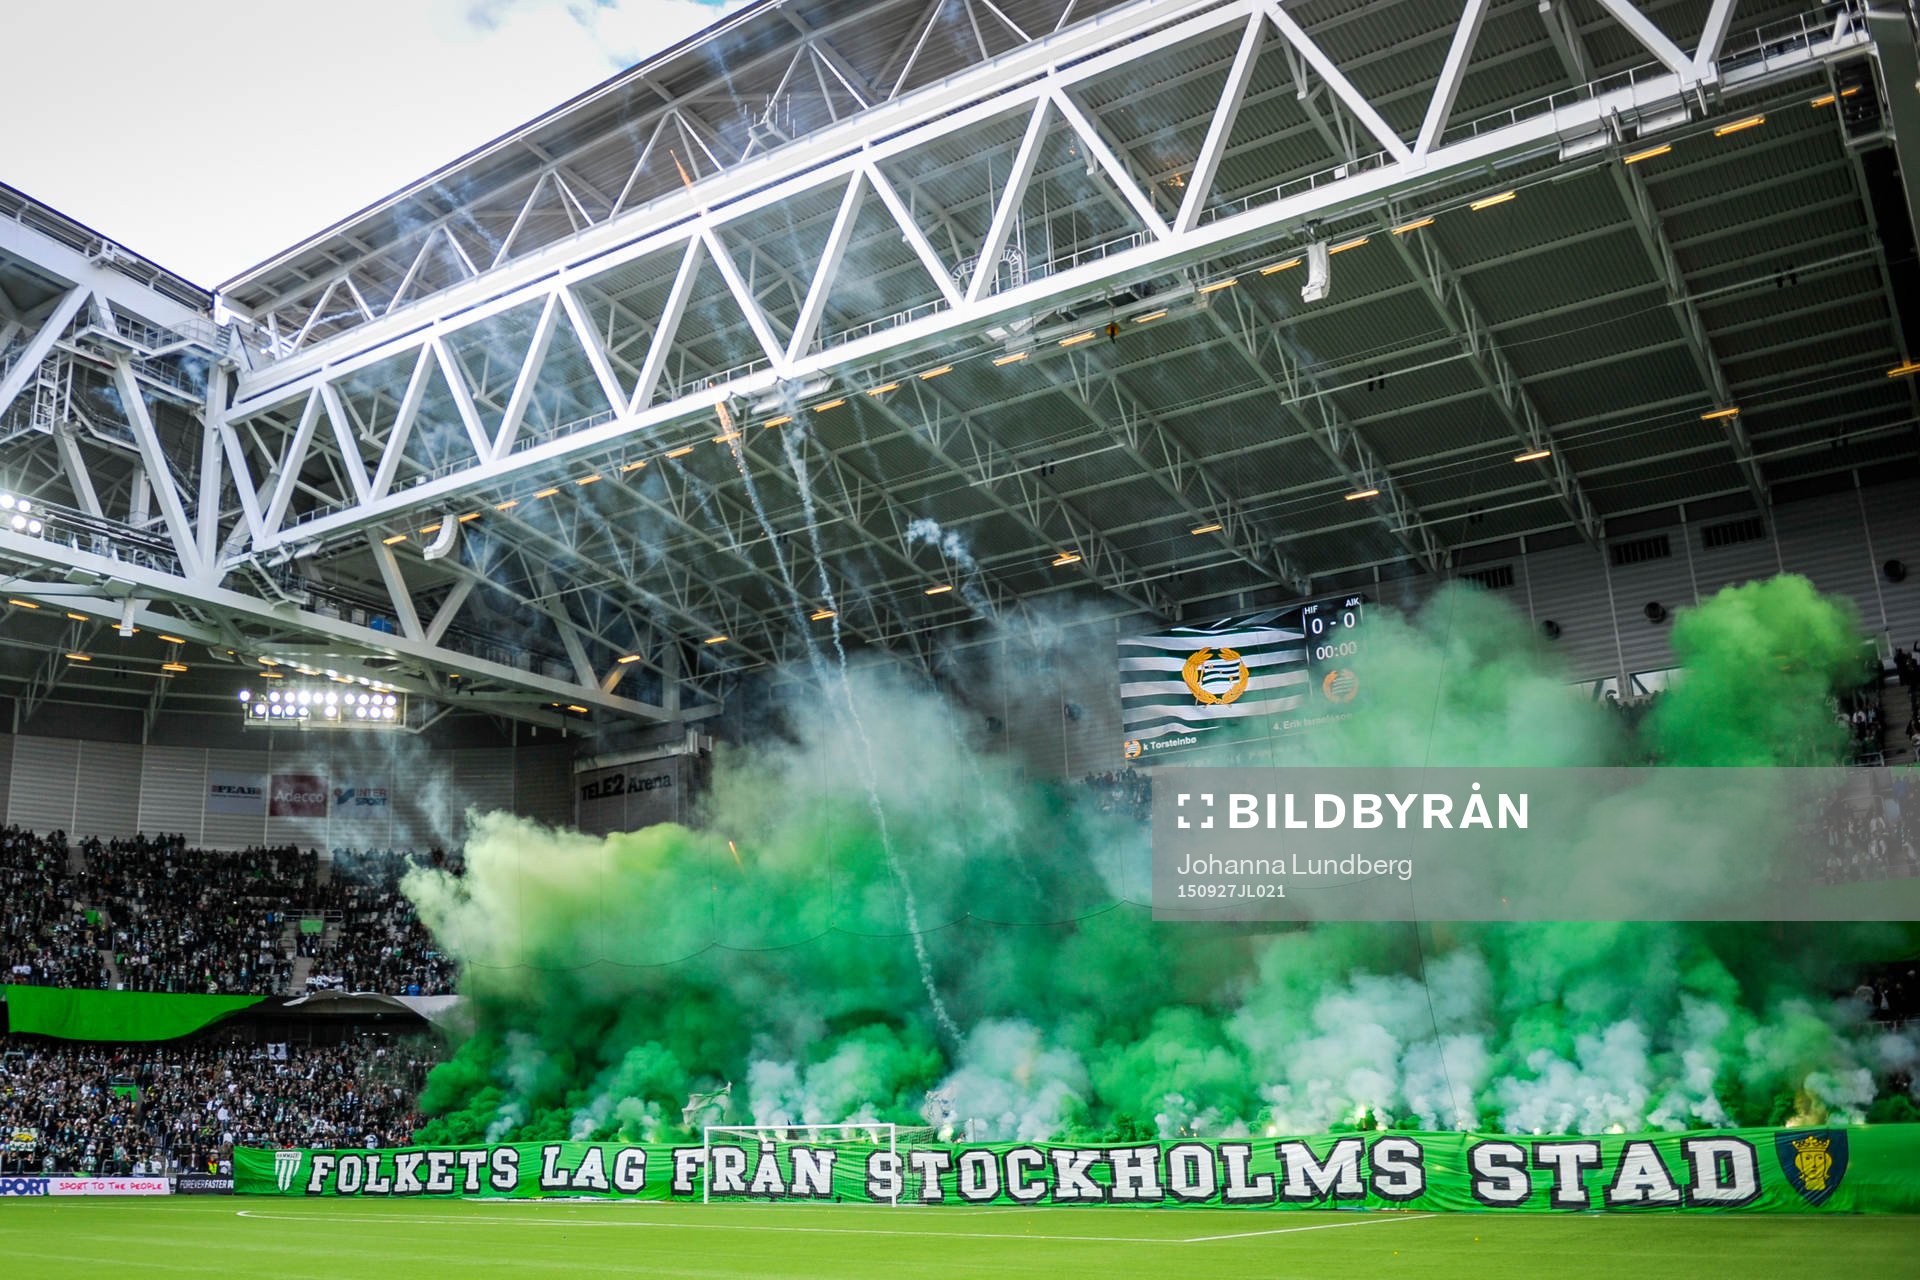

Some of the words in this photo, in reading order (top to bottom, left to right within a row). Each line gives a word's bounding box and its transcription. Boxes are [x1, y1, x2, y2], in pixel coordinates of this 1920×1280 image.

[1305, 605, 1318, 614] HIF
[1346, 598, 1360, 607] AIK
[1312, 618, 1323, 634] 0
[1344, 612, 1355, 628] 0
[1316, 641, 1357, 660] 00:00
[218, 785, 257, 794] PEAB
[581, 773, 625, 800] TELE2
[627, 774, 672, 794] Arena
[274, 790, 324, 803] Adecco
[306, 1145, 520, 1196] FOLKETS
[540, 1145, 646, 1195] LAG
[672, 1140, 835, 1197] FRÅN
[865, 1135, 1426, 1201] STOCKHOLMS
[1468, 1135, 1762, 1209] STAD
[0, 1178, 50, 1195] PORT
[59, 1182, 90, 1190] SPORT
[92, 1182, 105, 1190] TO
[130, 1182, 163, 1190] PEOPLE
